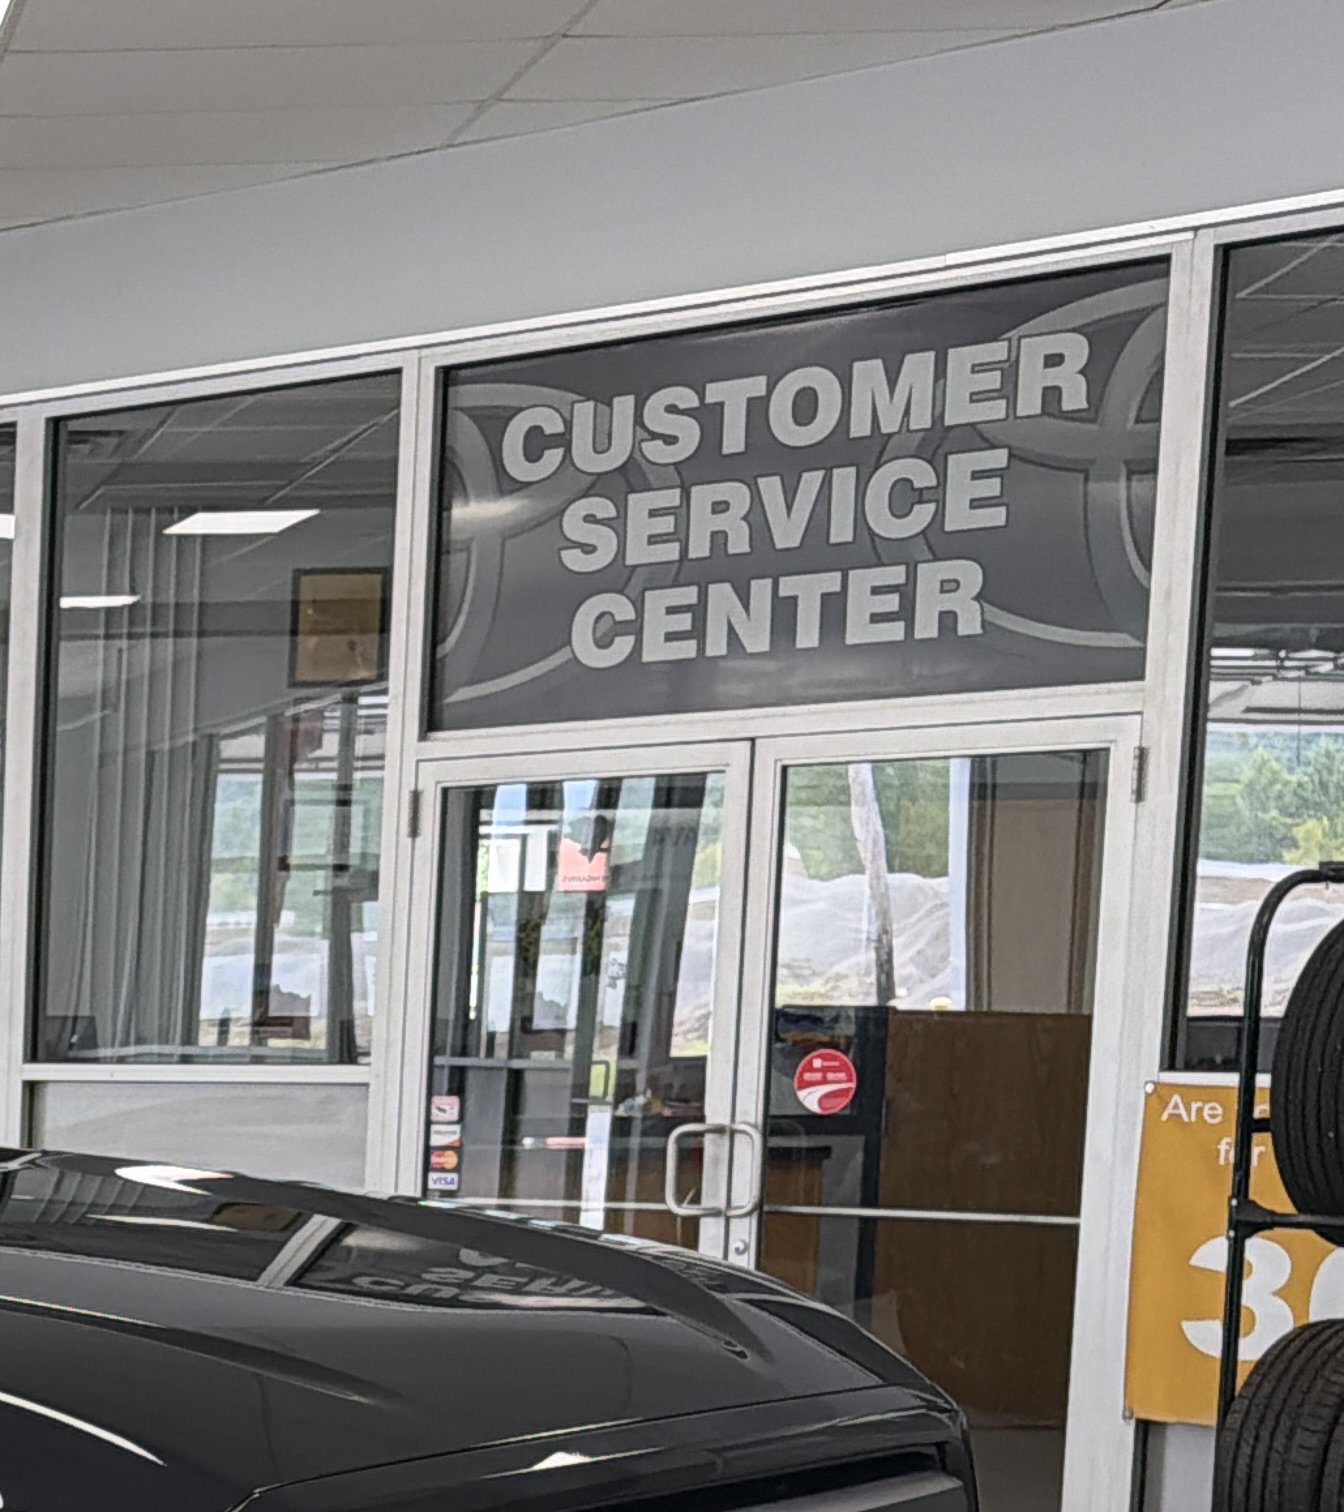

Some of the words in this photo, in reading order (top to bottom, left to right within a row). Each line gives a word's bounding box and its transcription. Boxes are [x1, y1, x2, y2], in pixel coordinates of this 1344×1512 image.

[500, 330, 1091, 484] CUSTOMER
[558, 448, 1010, 574] SERVICE
[570, 557, 986, 670] CENTER
[1160, 1093, 1224, 1124] Are
[1217, 1136, 1266, 1167] fr
[431, 1176, 456, 1186] VISA
[1180, 1235, 1344, 1361] 3
